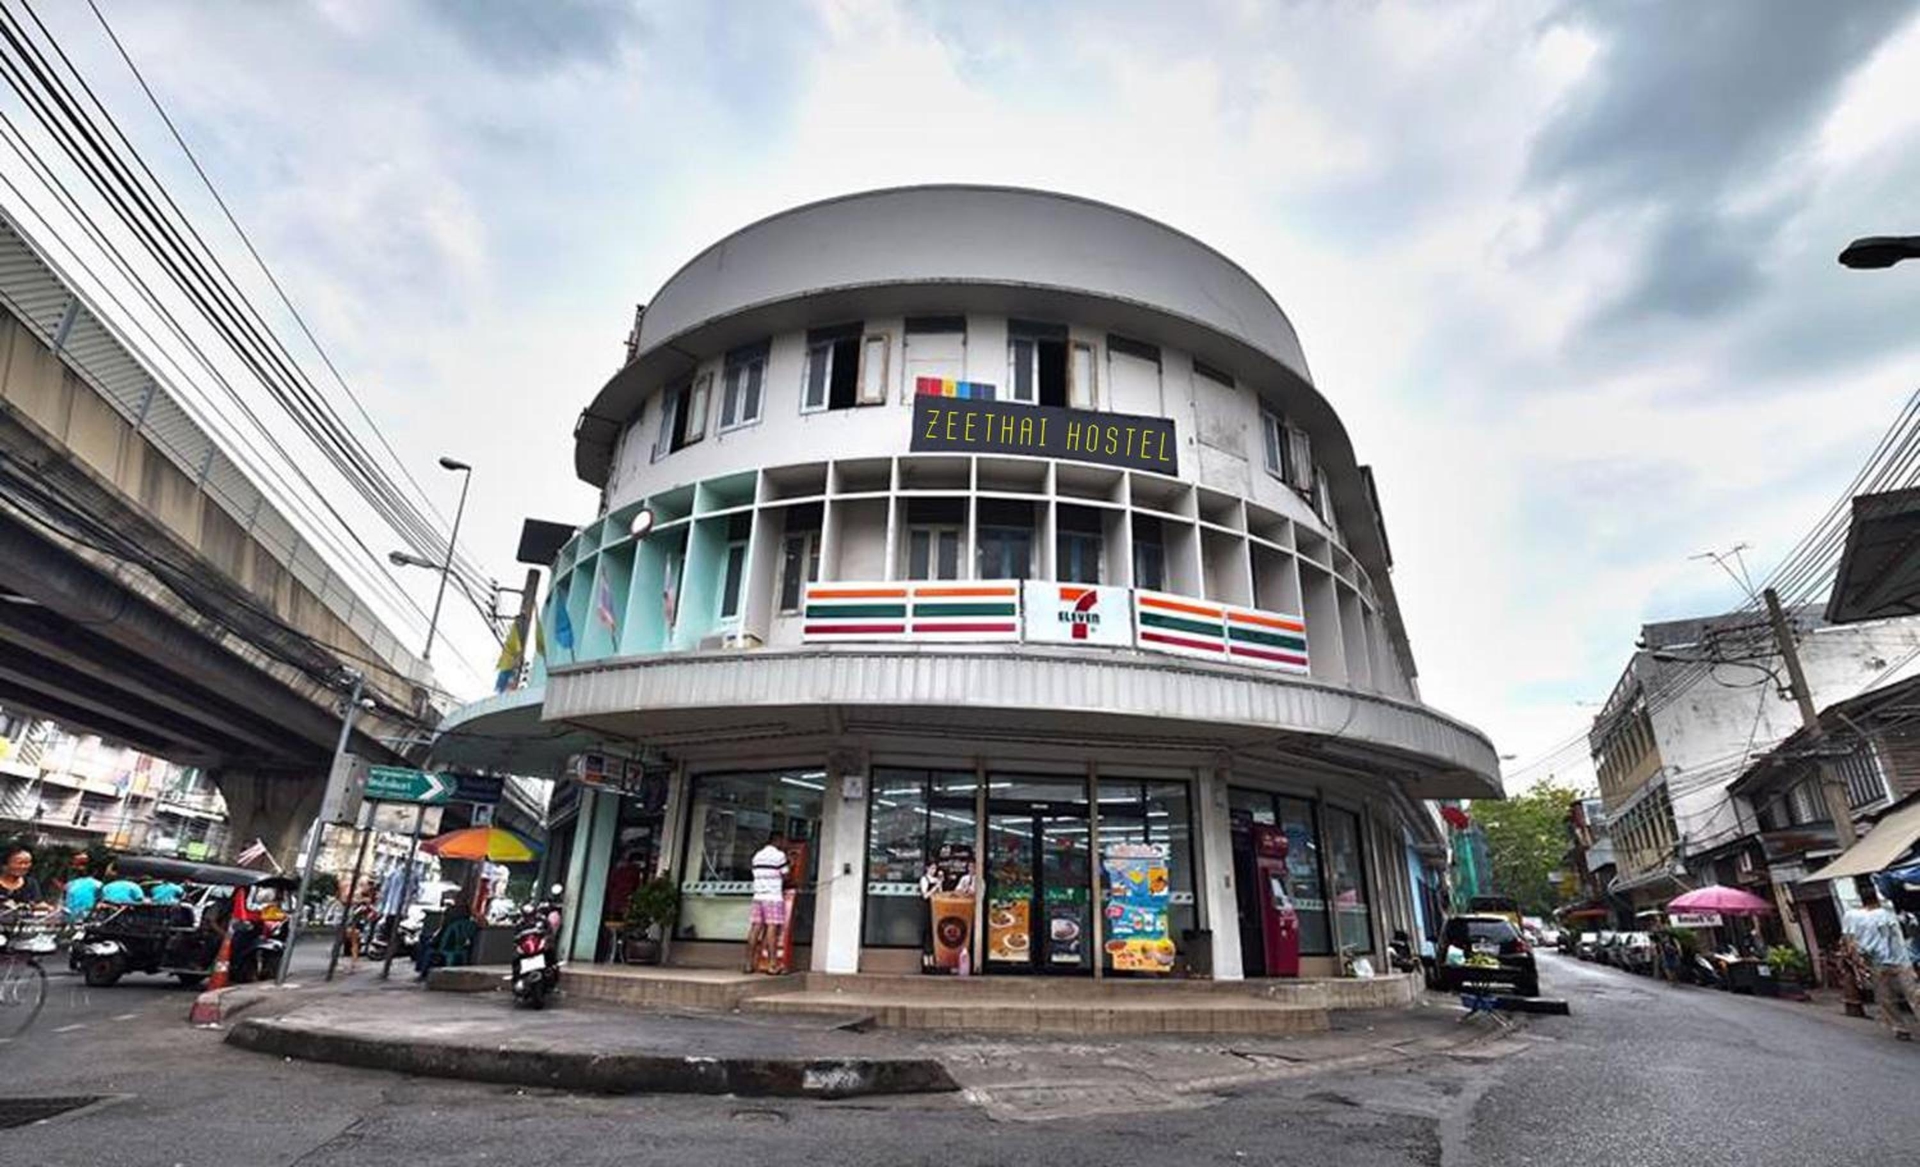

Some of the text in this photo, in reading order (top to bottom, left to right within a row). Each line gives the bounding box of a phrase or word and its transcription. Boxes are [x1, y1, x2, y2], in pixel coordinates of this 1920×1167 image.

[925, 409, 1170, 461] ZEETHAI HOSTEL
[1060, 587, 1098, 639] 7
